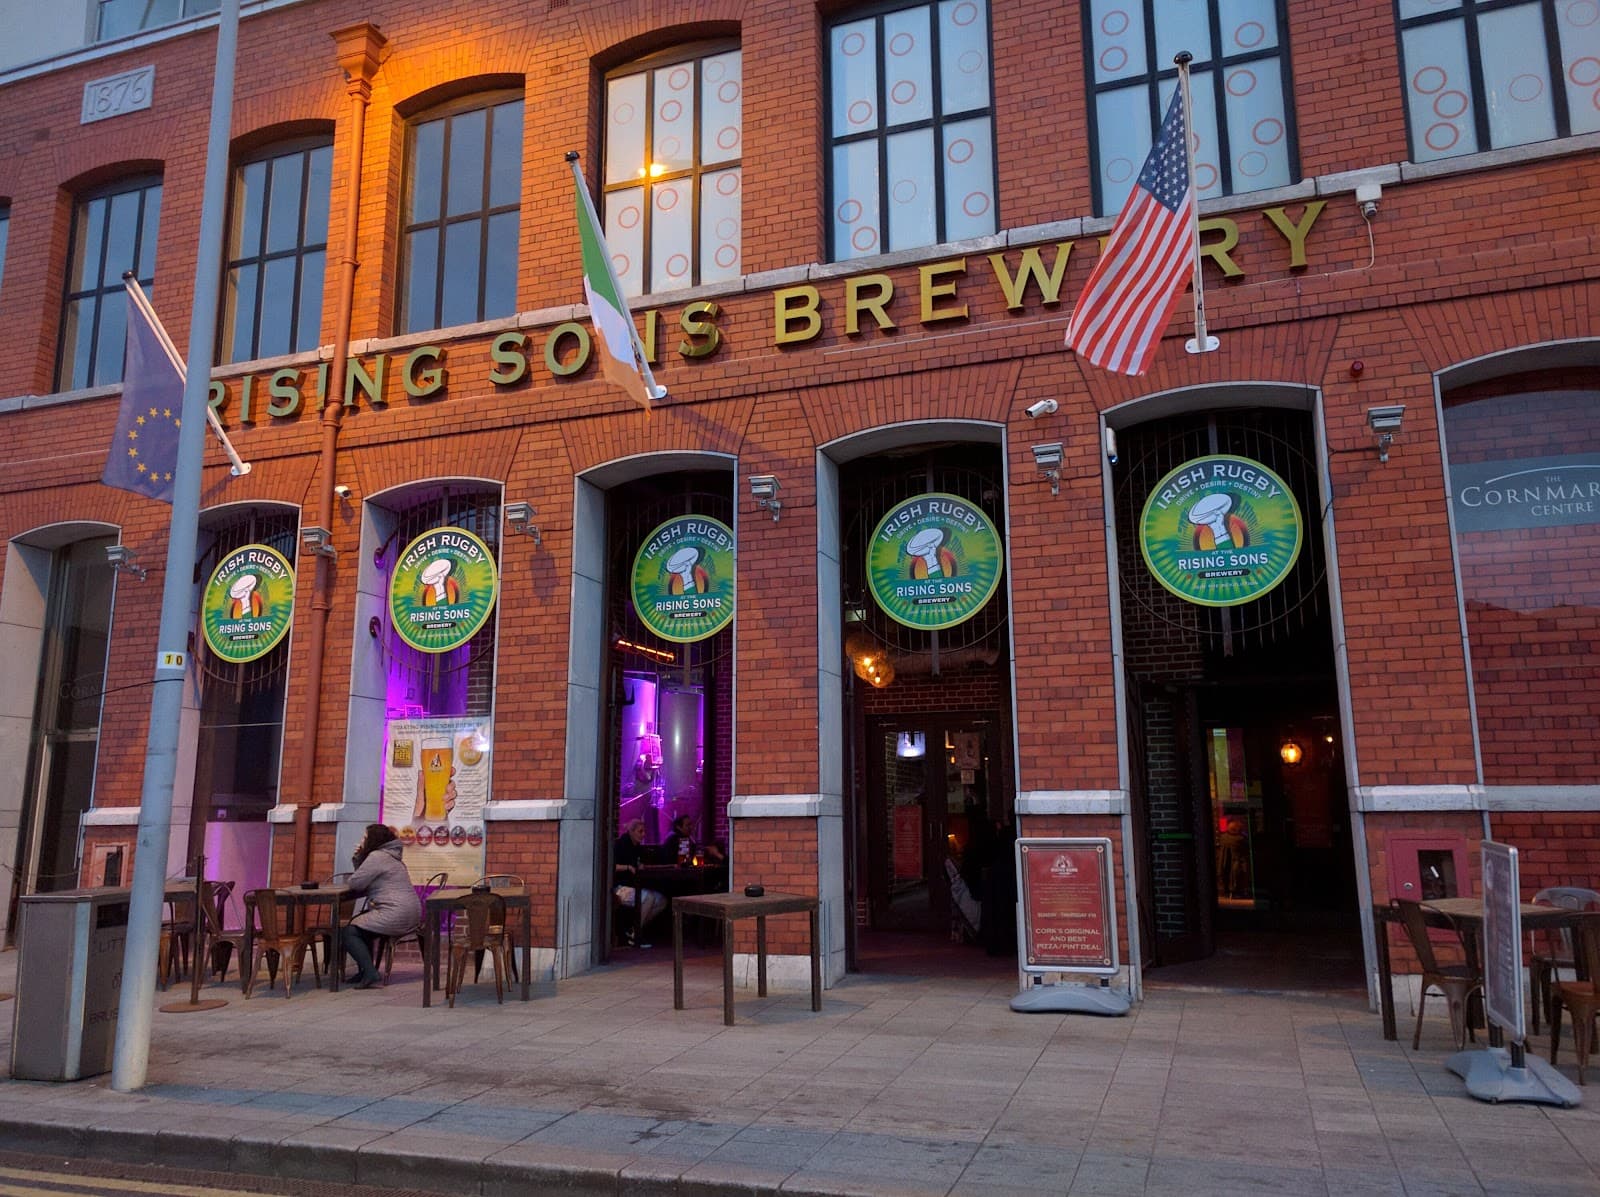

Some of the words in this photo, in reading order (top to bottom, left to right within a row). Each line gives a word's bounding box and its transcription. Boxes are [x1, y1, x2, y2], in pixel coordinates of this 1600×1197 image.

[87, 73, 147, 115] 1876
[774, 200, 1327, 347] BREWRY
[1156, 467, 1206, 511] IRISH
[1213, 464, 1282, 499] RUGBY
[1545, 475, 1561, 483] THE
[1176, 489, 1196, 507] DRIVE
[1200, 481, 1227, 490] DESIRE
[1233, 482, 1262, 499] DESTINY
[1531, 501, 1594, 516] CENTRE
[880, 504, 922, 542] IRISH
[929, 501, 986, 534] RUGBY
[644, 525, 681, 560] IRISH
[687, 523, 734, 552] RUGBY
[401, 537, 437, 572] IRISH
[441, 535, 486, 564] RUGBY
[1178, 555, 1225, 571] RISING
[1230, 553, 1269, 566] SONS
[215, 554, 245, 586] IRISH
[248, 552, 288, 580] RUGBY
[1205, 570, 1244, 578] BREWERY
[896, 584, 935, 597] RISING
[940, 582, 972, 594] SONS
[656, 600, 689, 612] RISING
[693, 598, 721, 609] SONS
[410, 611, 440, 622] RISING
[444, 609, 470, 620] SONS
[219, 623, 245, 634] RISING
[248, 621, 272, 632] SONS
[1080, 943, 1102, 951] DEAL
